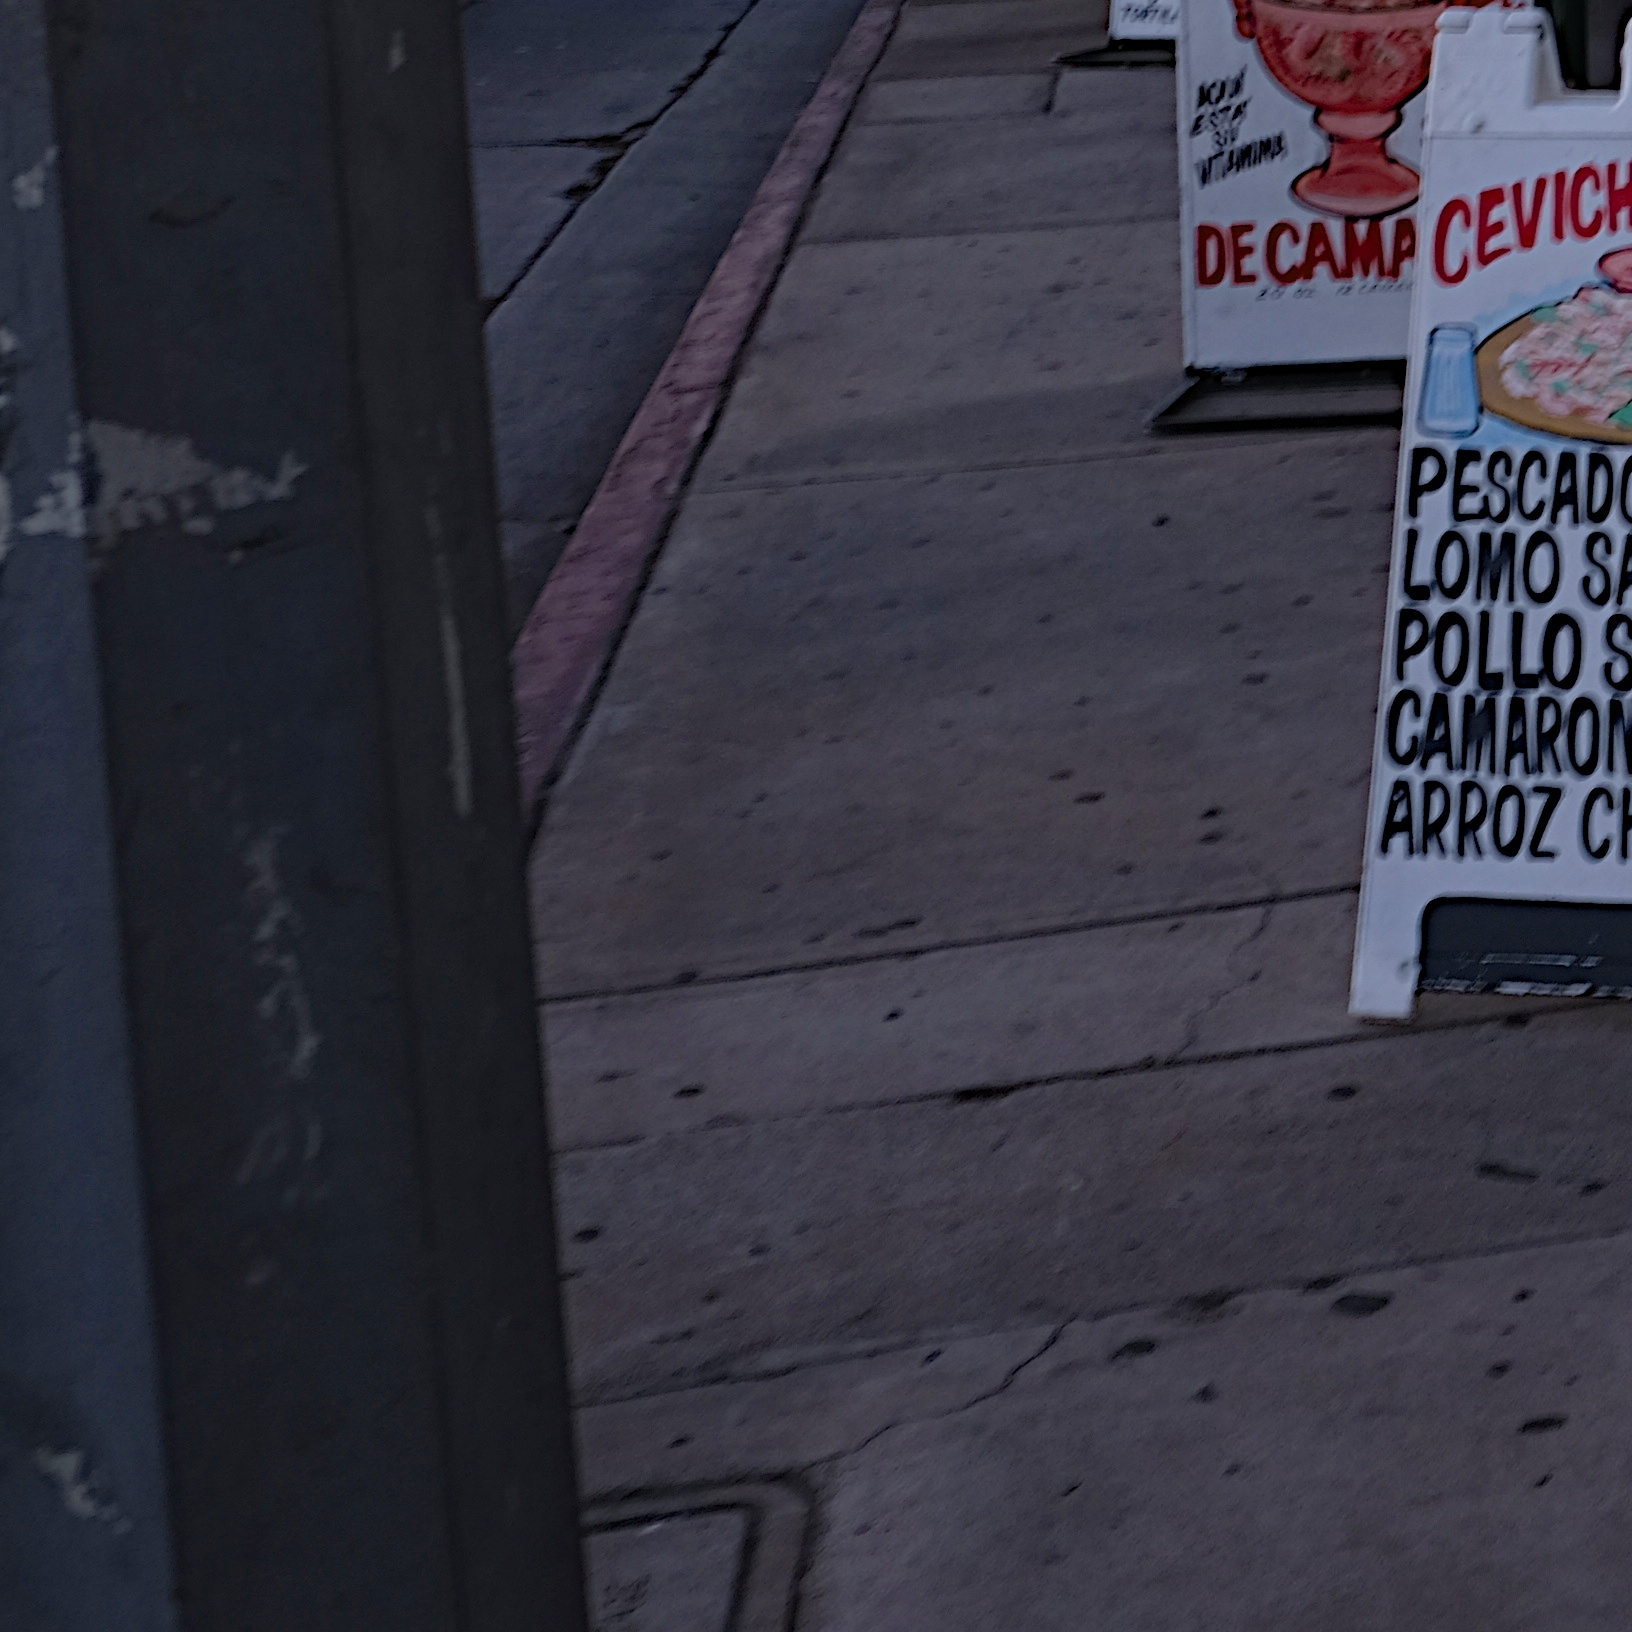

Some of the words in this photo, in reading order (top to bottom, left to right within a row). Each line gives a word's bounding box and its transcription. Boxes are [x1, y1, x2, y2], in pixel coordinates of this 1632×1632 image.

[1197, 224, 1256, 285] DE
[1266, 218, 1416, 285] CAMA
[1401, 530, 1561, 604] LOMO
[1397, 609, 1583, 691] POLLO
[1380, 780, 1564, 860] ARROZ
